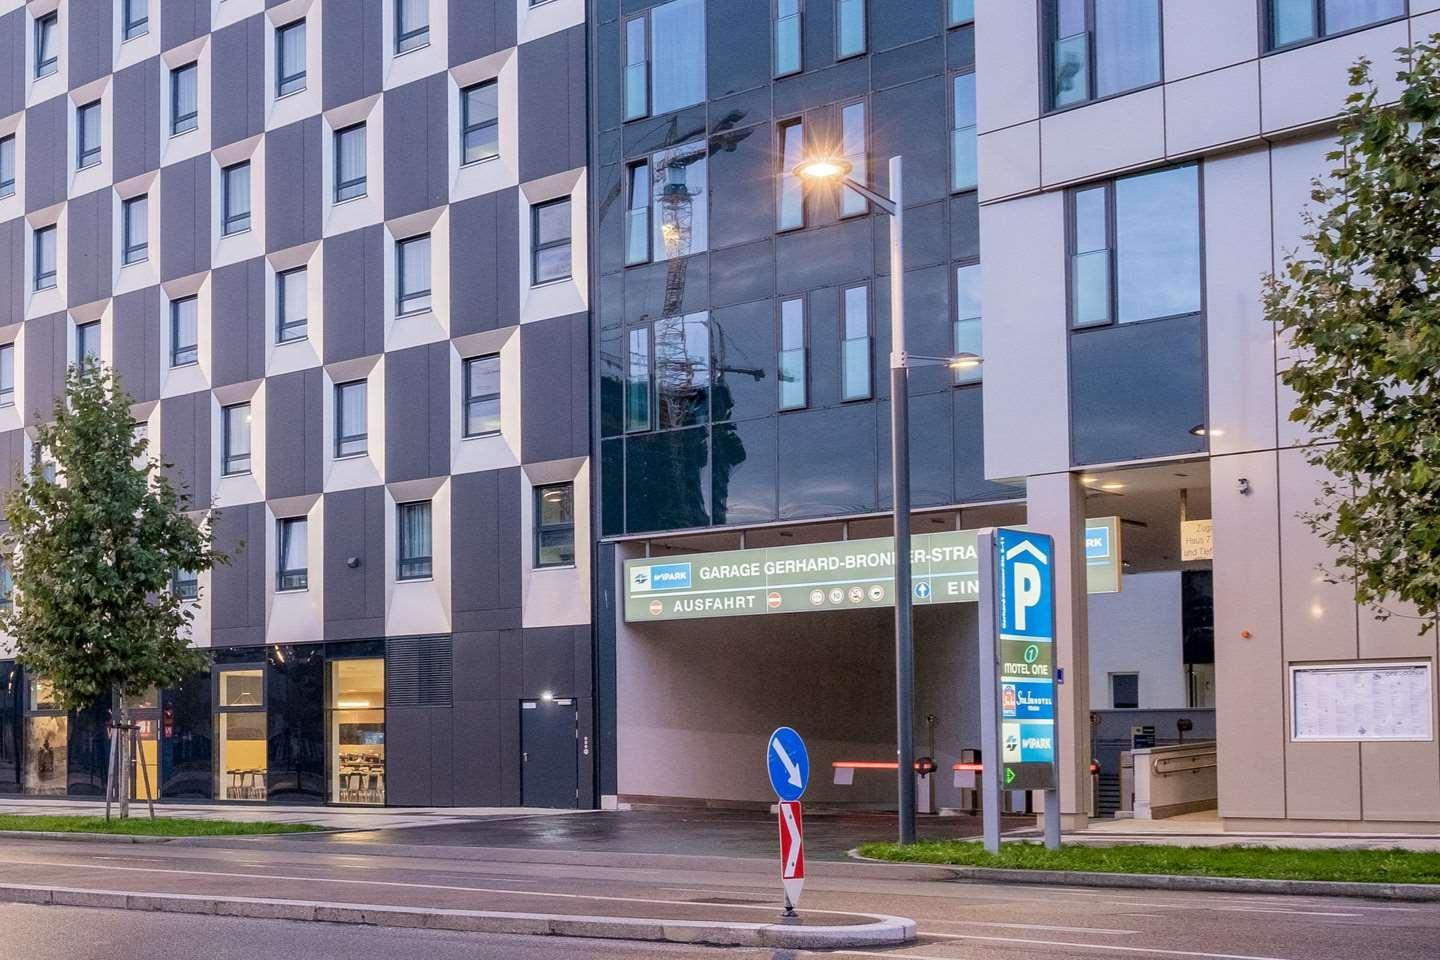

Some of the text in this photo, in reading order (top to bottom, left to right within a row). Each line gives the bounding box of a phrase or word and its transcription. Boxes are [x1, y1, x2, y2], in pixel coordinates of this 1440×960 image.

[699, 563, 761, 580] GARAGE
[673, 595, 756, 613] AUSFAHRT
[1014, 561, 1042, 631] P
[1004, 663, 1048, 675] MOTEL ONE
